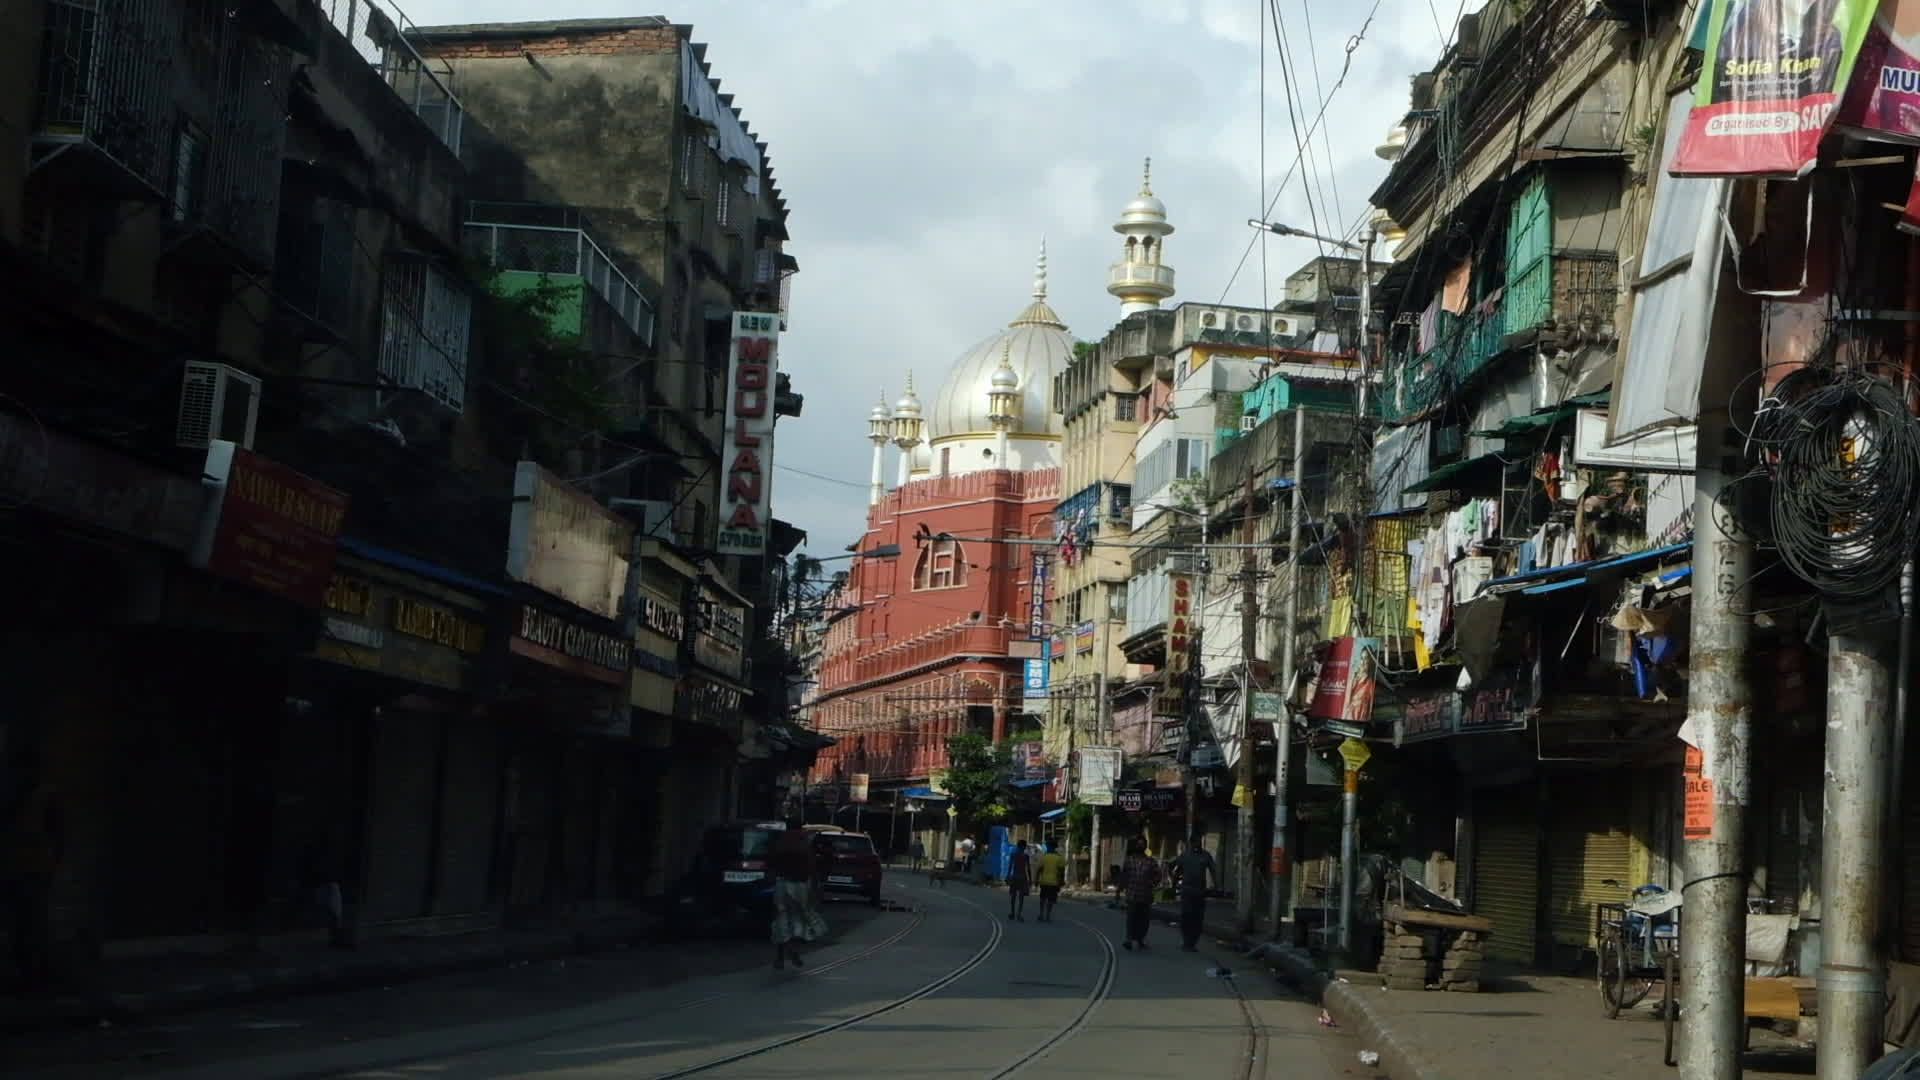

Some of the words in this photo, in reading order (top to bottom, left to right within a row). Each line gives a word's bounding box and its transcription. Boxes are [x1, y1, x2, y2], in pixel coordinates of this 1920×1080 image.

[1725, 59, 1773, 75] Sofia
[1882, 68, 1920, 93] MU
[740, 315, 772, 331] NEW
[1031, 555, 1044, 637] STANDARD
[521, 605, 563, 650] BEAUTY
